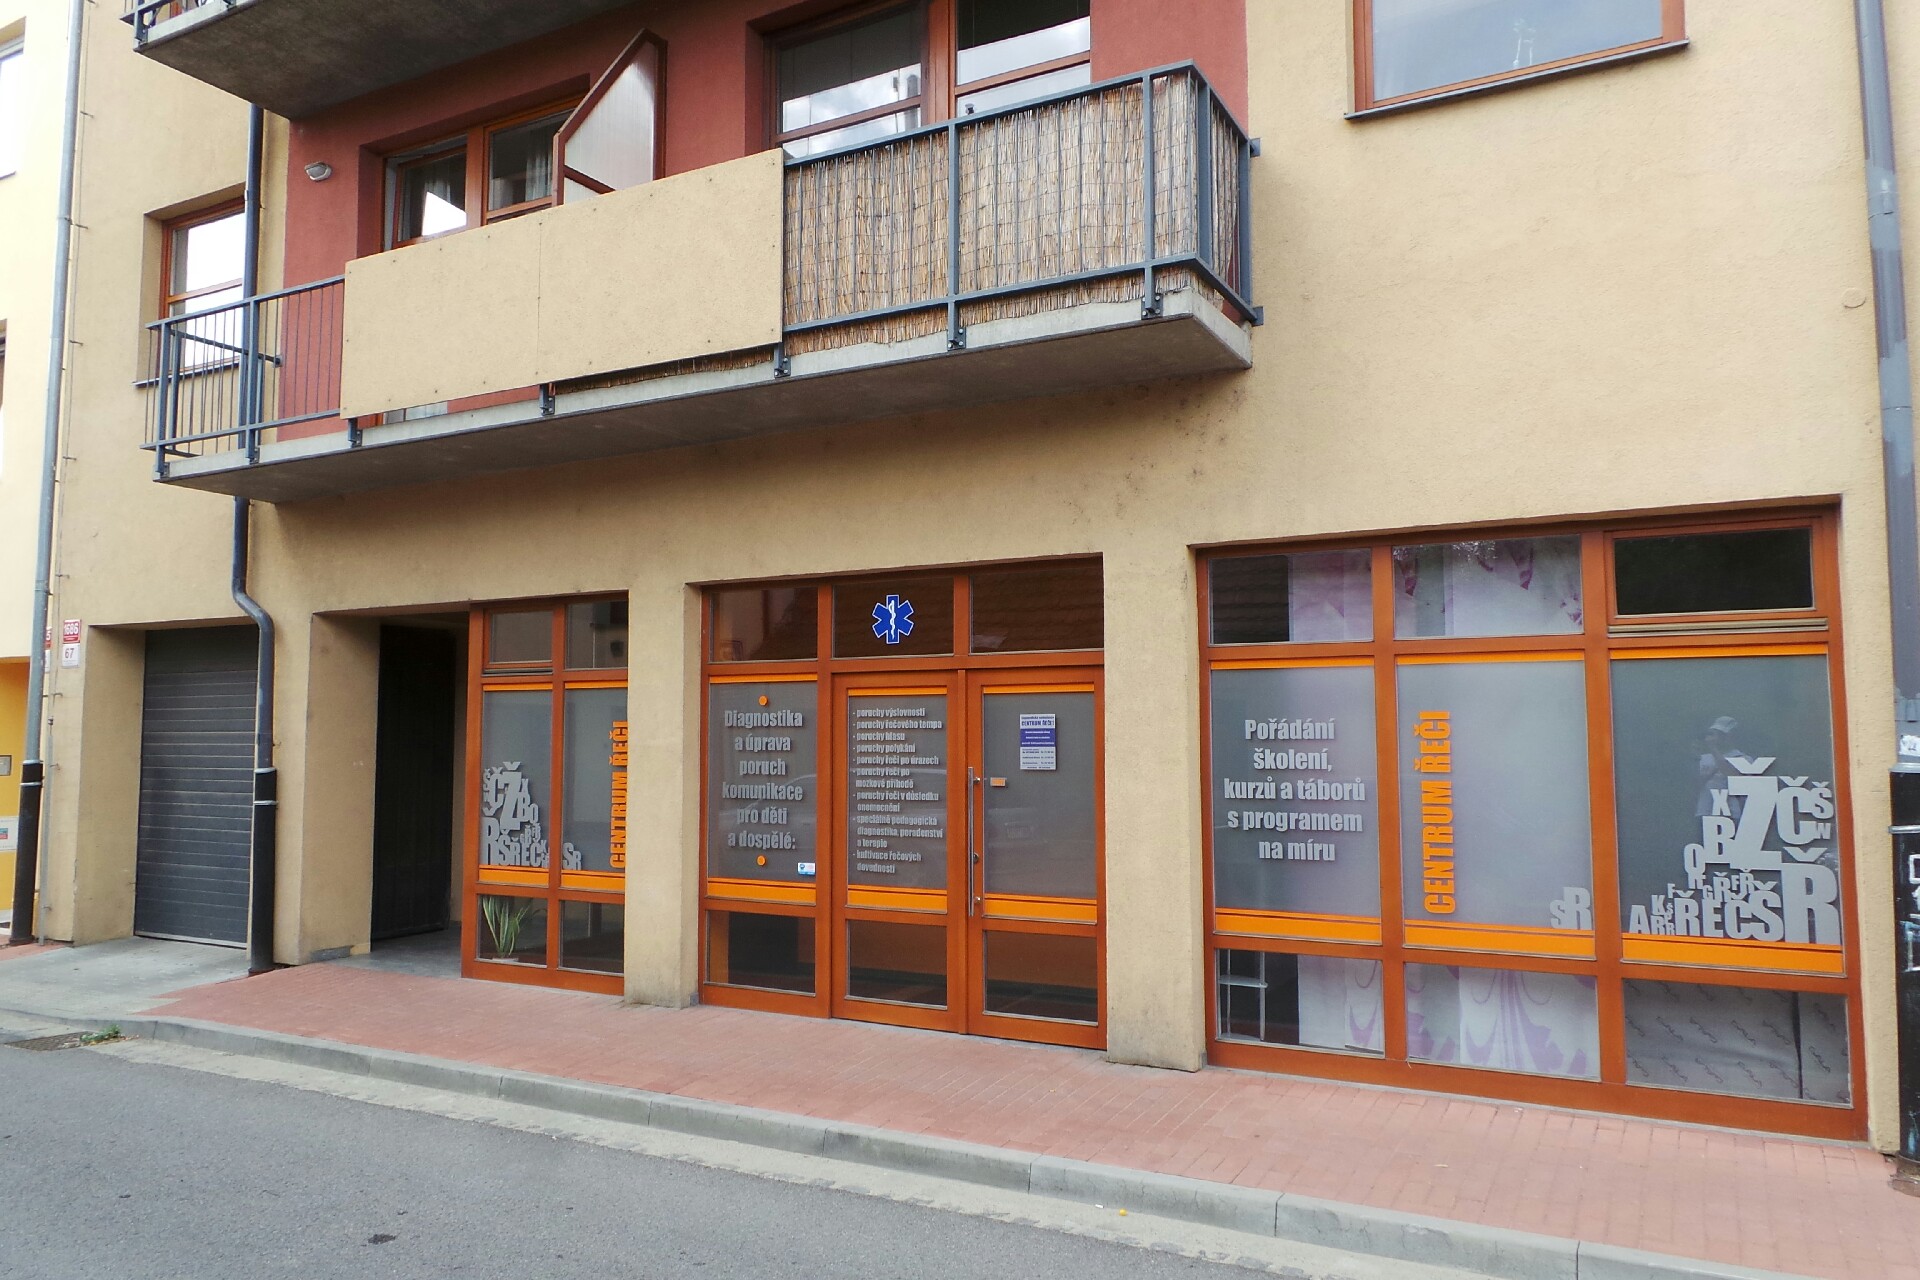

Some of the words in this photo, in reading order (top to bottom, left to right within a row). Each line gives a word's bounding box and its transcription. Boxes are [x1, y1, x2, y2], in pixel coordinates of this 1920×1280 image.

[65, 648, 74, 658] 67
[724, 710, 803, 728] Diagnostika
[856, 708, 885, 718] poruchy
[856, 720, 885, 730] poruchy
[1244, 718, 1335, 740] Pořádání
[608, 721, 628, 766] ŘEČI
[735, 737, 742, 750] a
[746, 734, 791, 752] úprava
[856, 732, 885, 742] poruchy
[1413, 711, 1451, 773] ŘEČI
[856, 744, 885, 754] poruchy
[740, 758, 786, 776] poruch
[856, 756, 885, 766] poruchy
[1254, 748, 1332, 772] školení,
[722, 782, 803, 800] komunikace
[856, 791, 885, 800] poruchy
[1224, 776, 1276, 799] kurzů
[1280, 782, 1293, 800] a
[1297, 777, 1365, 801] táborů
[610, 772, 628, 868] CENTRUM
[736, 808, 758, 825] pro
[761, 807, 788, 824] děti
[1227, 811, 1238, 828] s
[1243, 810, 1363, 832] programem
[728, 832, 735, 846] a
[739, 830, 796, 850] dospělé:
[1422, 780, 1456, 914] CENTRUM
[1259, 841, 1283, 859] na
[1288, 839, 1336, 861] míru
